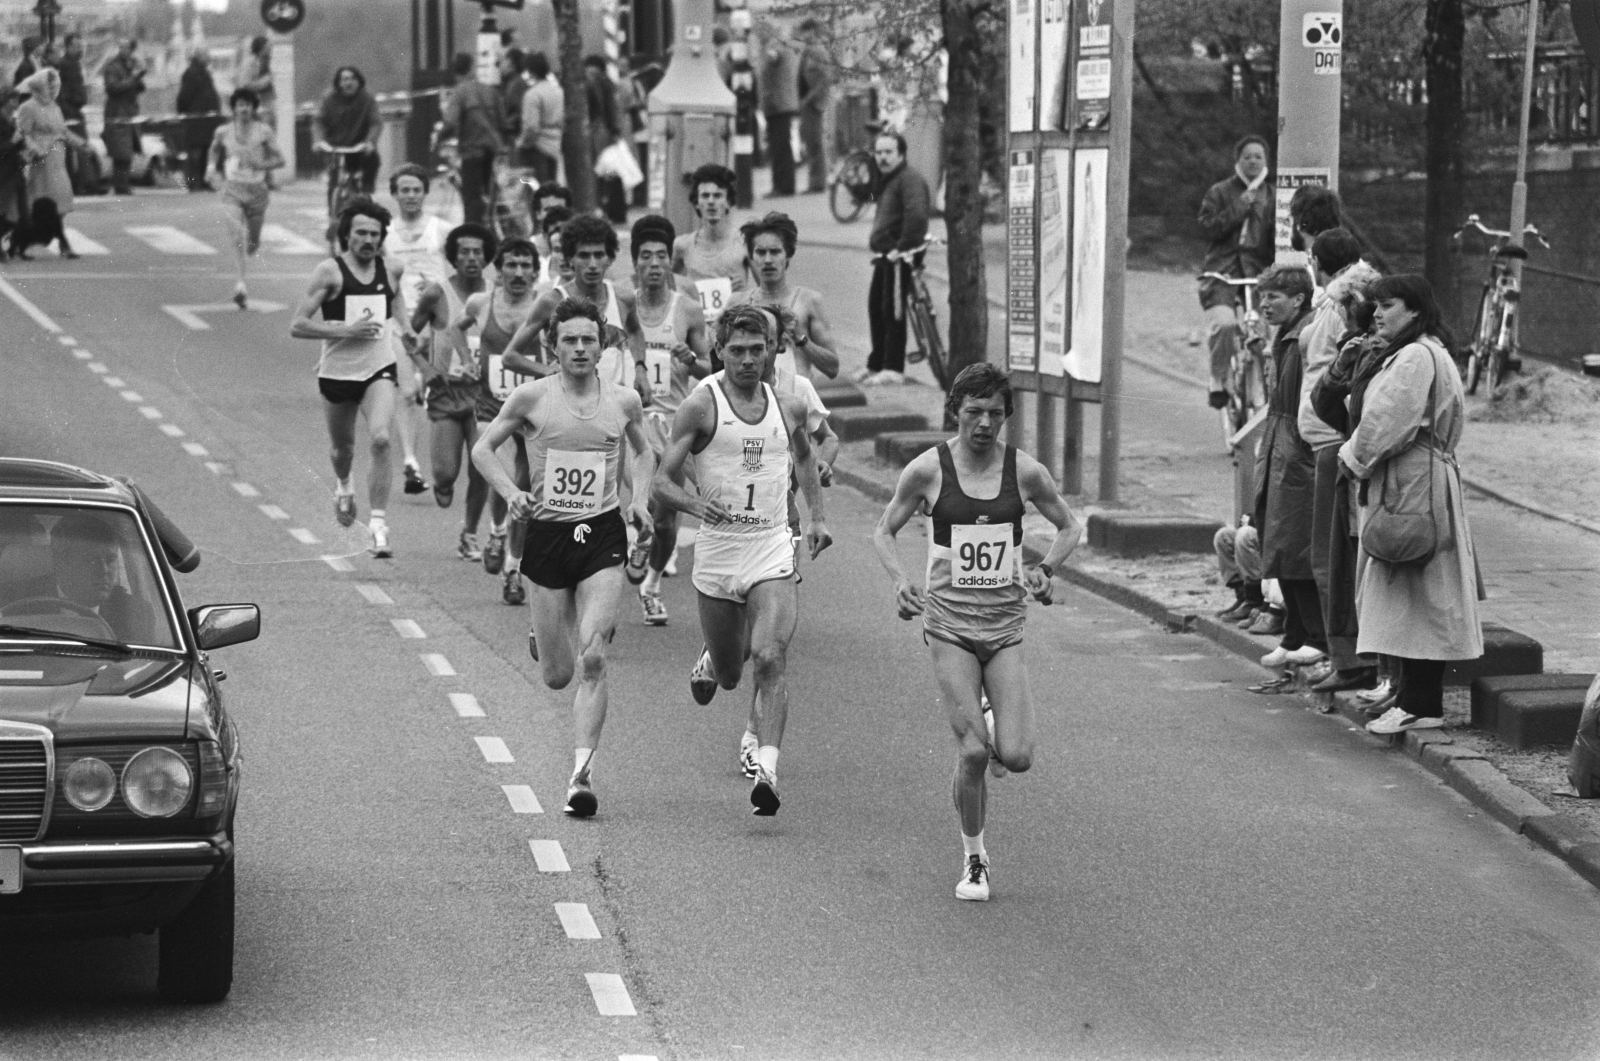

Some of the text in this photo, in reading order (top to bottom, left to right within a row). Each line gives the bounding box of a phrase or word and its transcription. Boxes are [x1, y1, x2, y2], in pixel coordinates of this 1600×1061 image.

[699, 290, 722, 309] 18
[552, 467, 597, 496] 392
[548, 498, 585, 509] adidas
[744, 483, 755, 511] 1
[730, 513, 760, 525] didas
[959, 541, 1007, 572] 967
[958, 575, 998, 586] adidas
